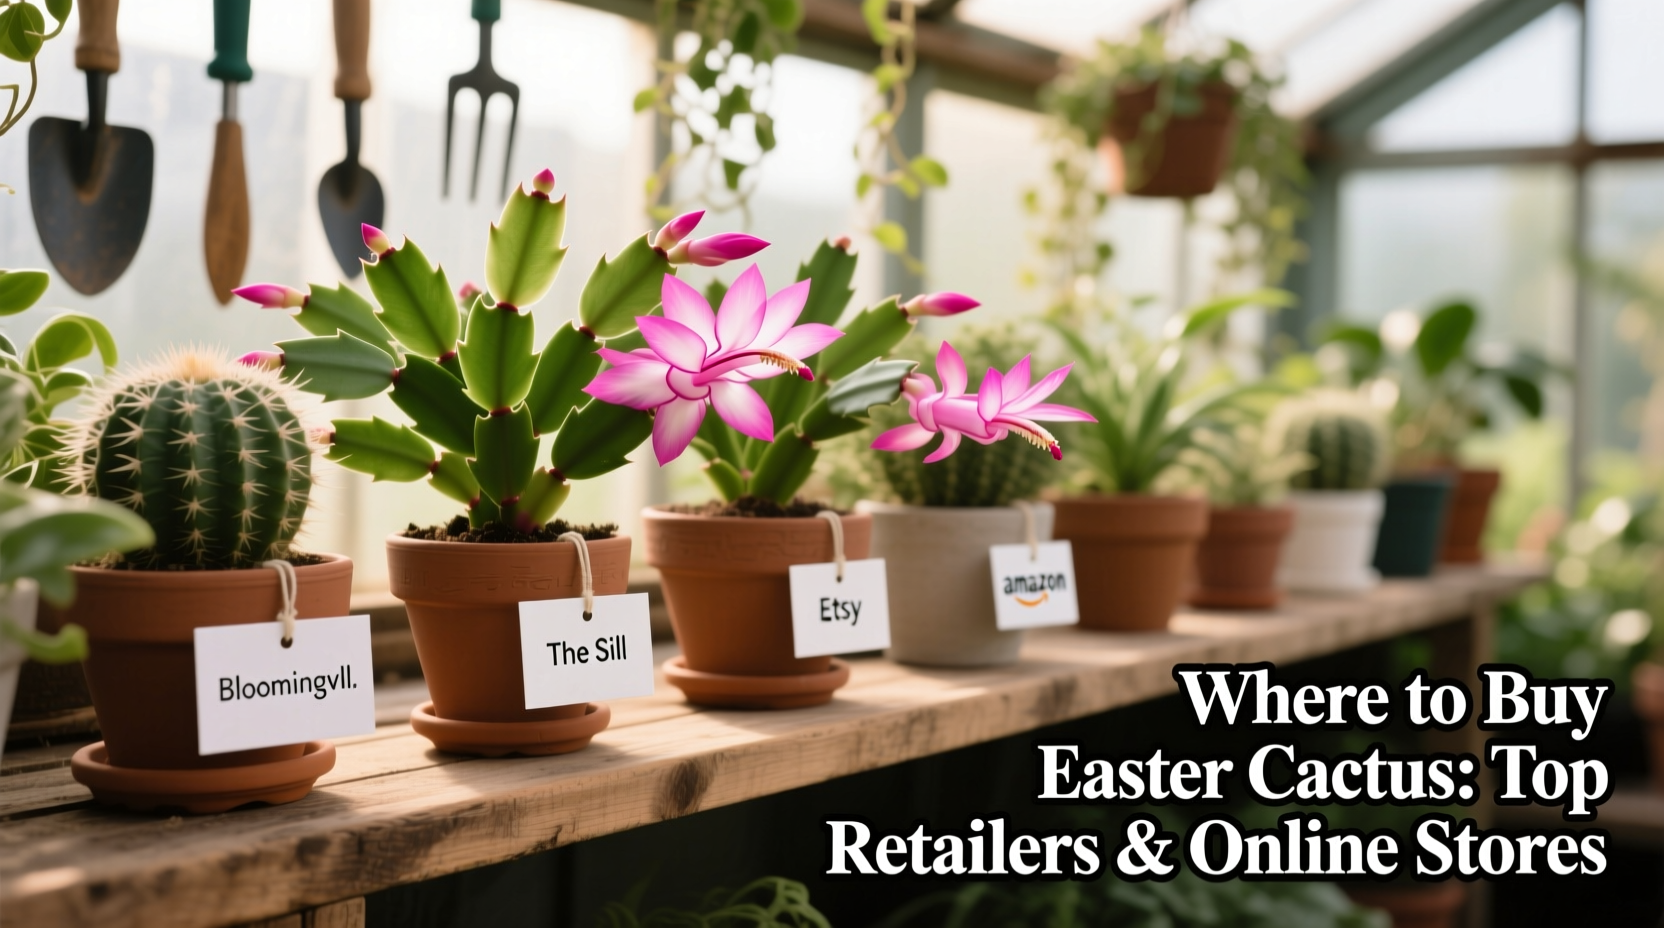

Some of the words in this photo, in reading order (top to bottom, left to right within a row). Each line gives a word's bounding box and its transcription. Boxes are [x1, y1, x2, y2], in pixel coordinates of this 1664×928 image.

[1004, 572, 1066, 595] amazon
[819, 597, 863, 626] Etsy
[546, 637, 590, 666] The
[595, 634, 627, 663] Sill
[219, 664, 358, 702] Bloomingvll.
